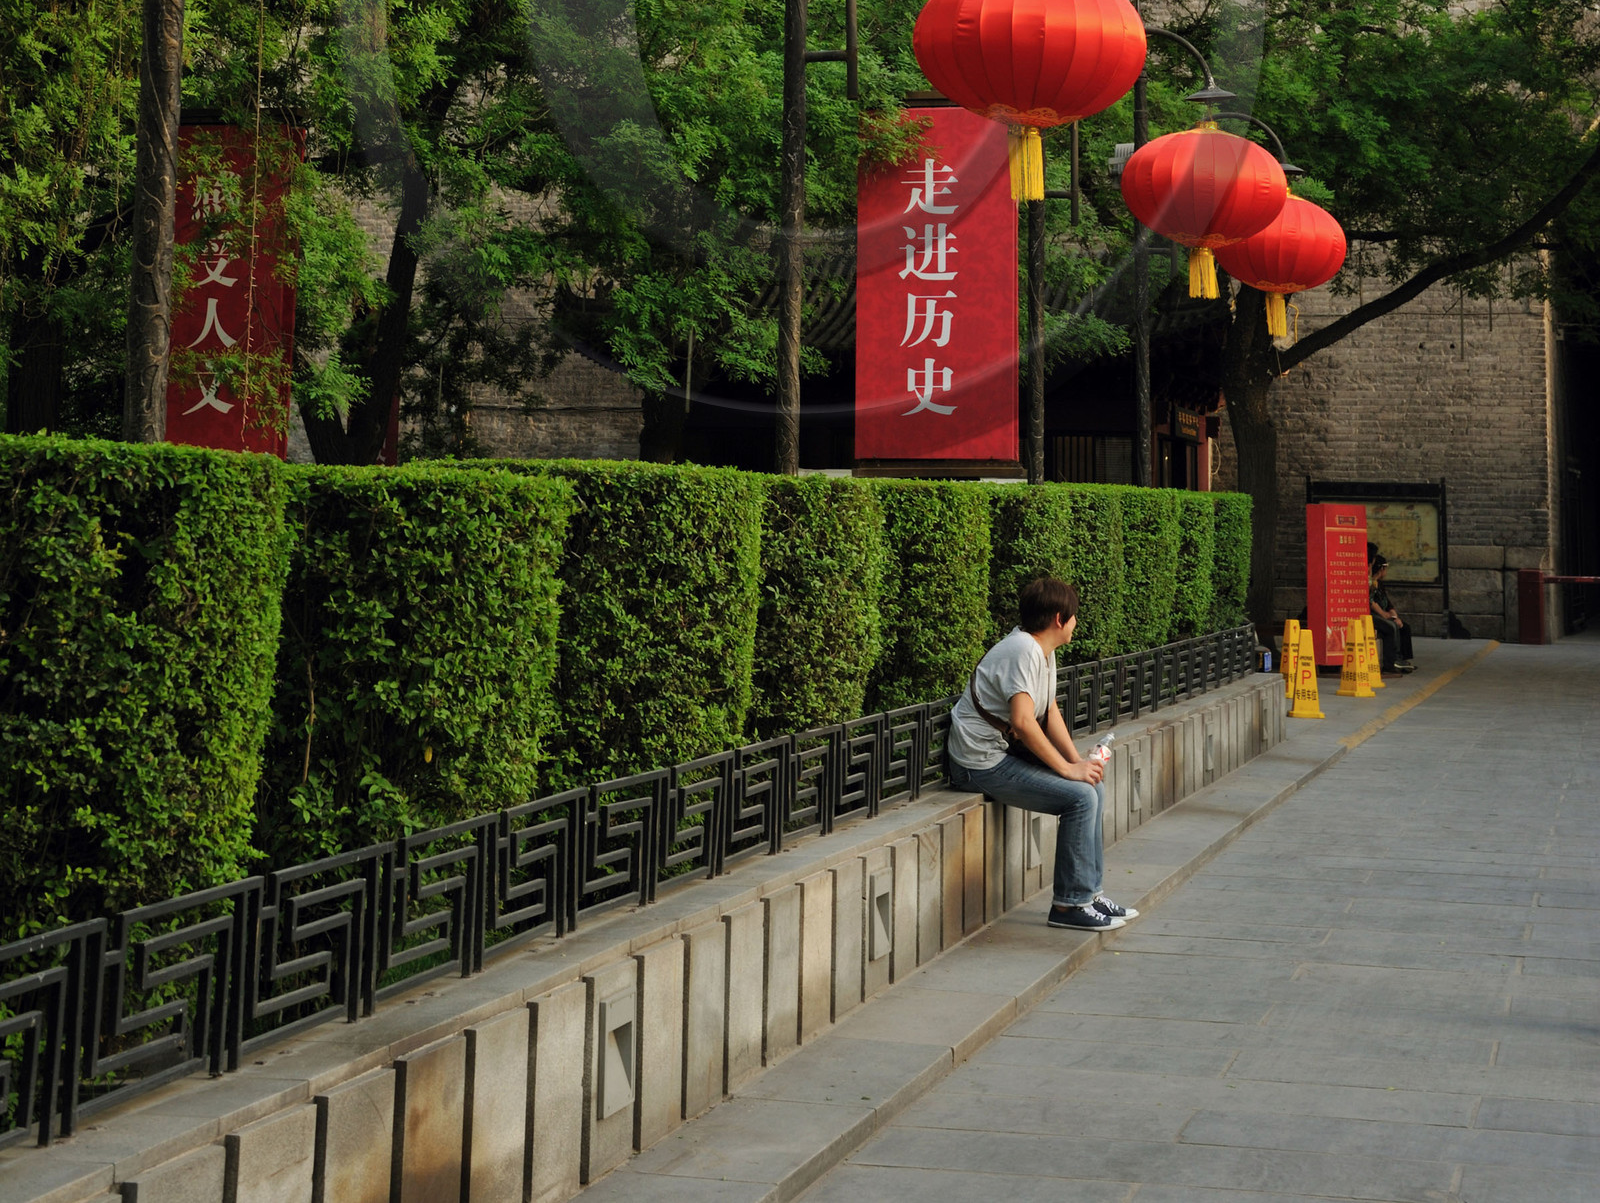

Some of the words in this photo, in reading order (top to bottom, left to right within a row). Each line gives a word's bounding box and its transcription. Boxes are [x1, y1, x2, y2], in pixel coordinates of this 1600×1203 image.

[898, 158, 960, 416] 走进历史
[1347, 654, 1354, 668] P
[1359, 655, 1365, 668] P
[1302, 670, 1312, 685] P
